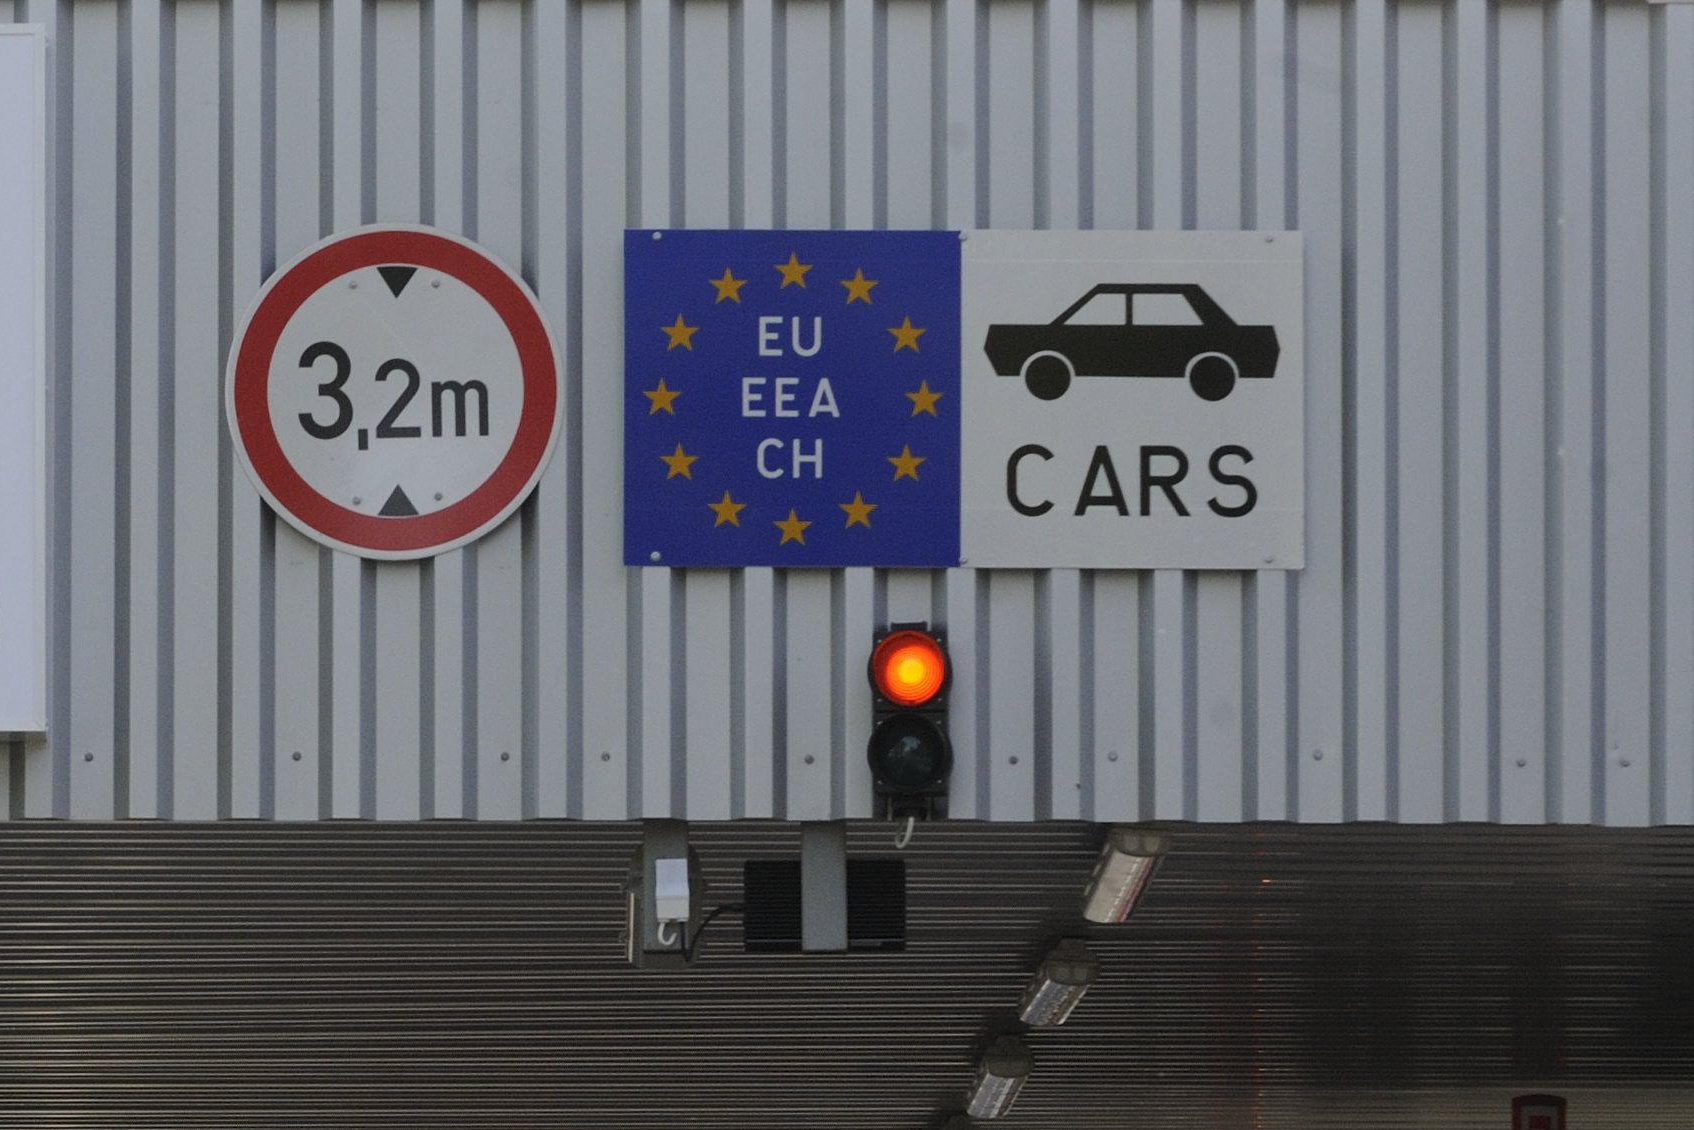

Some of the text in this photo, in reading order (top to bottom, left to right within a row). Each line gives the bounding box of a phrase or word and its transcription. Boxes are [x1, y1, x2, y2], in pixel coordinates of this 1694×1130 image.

[759, 315, 823, 358] EU
[298, 341, 491, 452] 3,2m
[742, 377, 841, 419] EEA
[757, 438, 824, 480] CH
[1006, 443, 1260, 520] CARS
